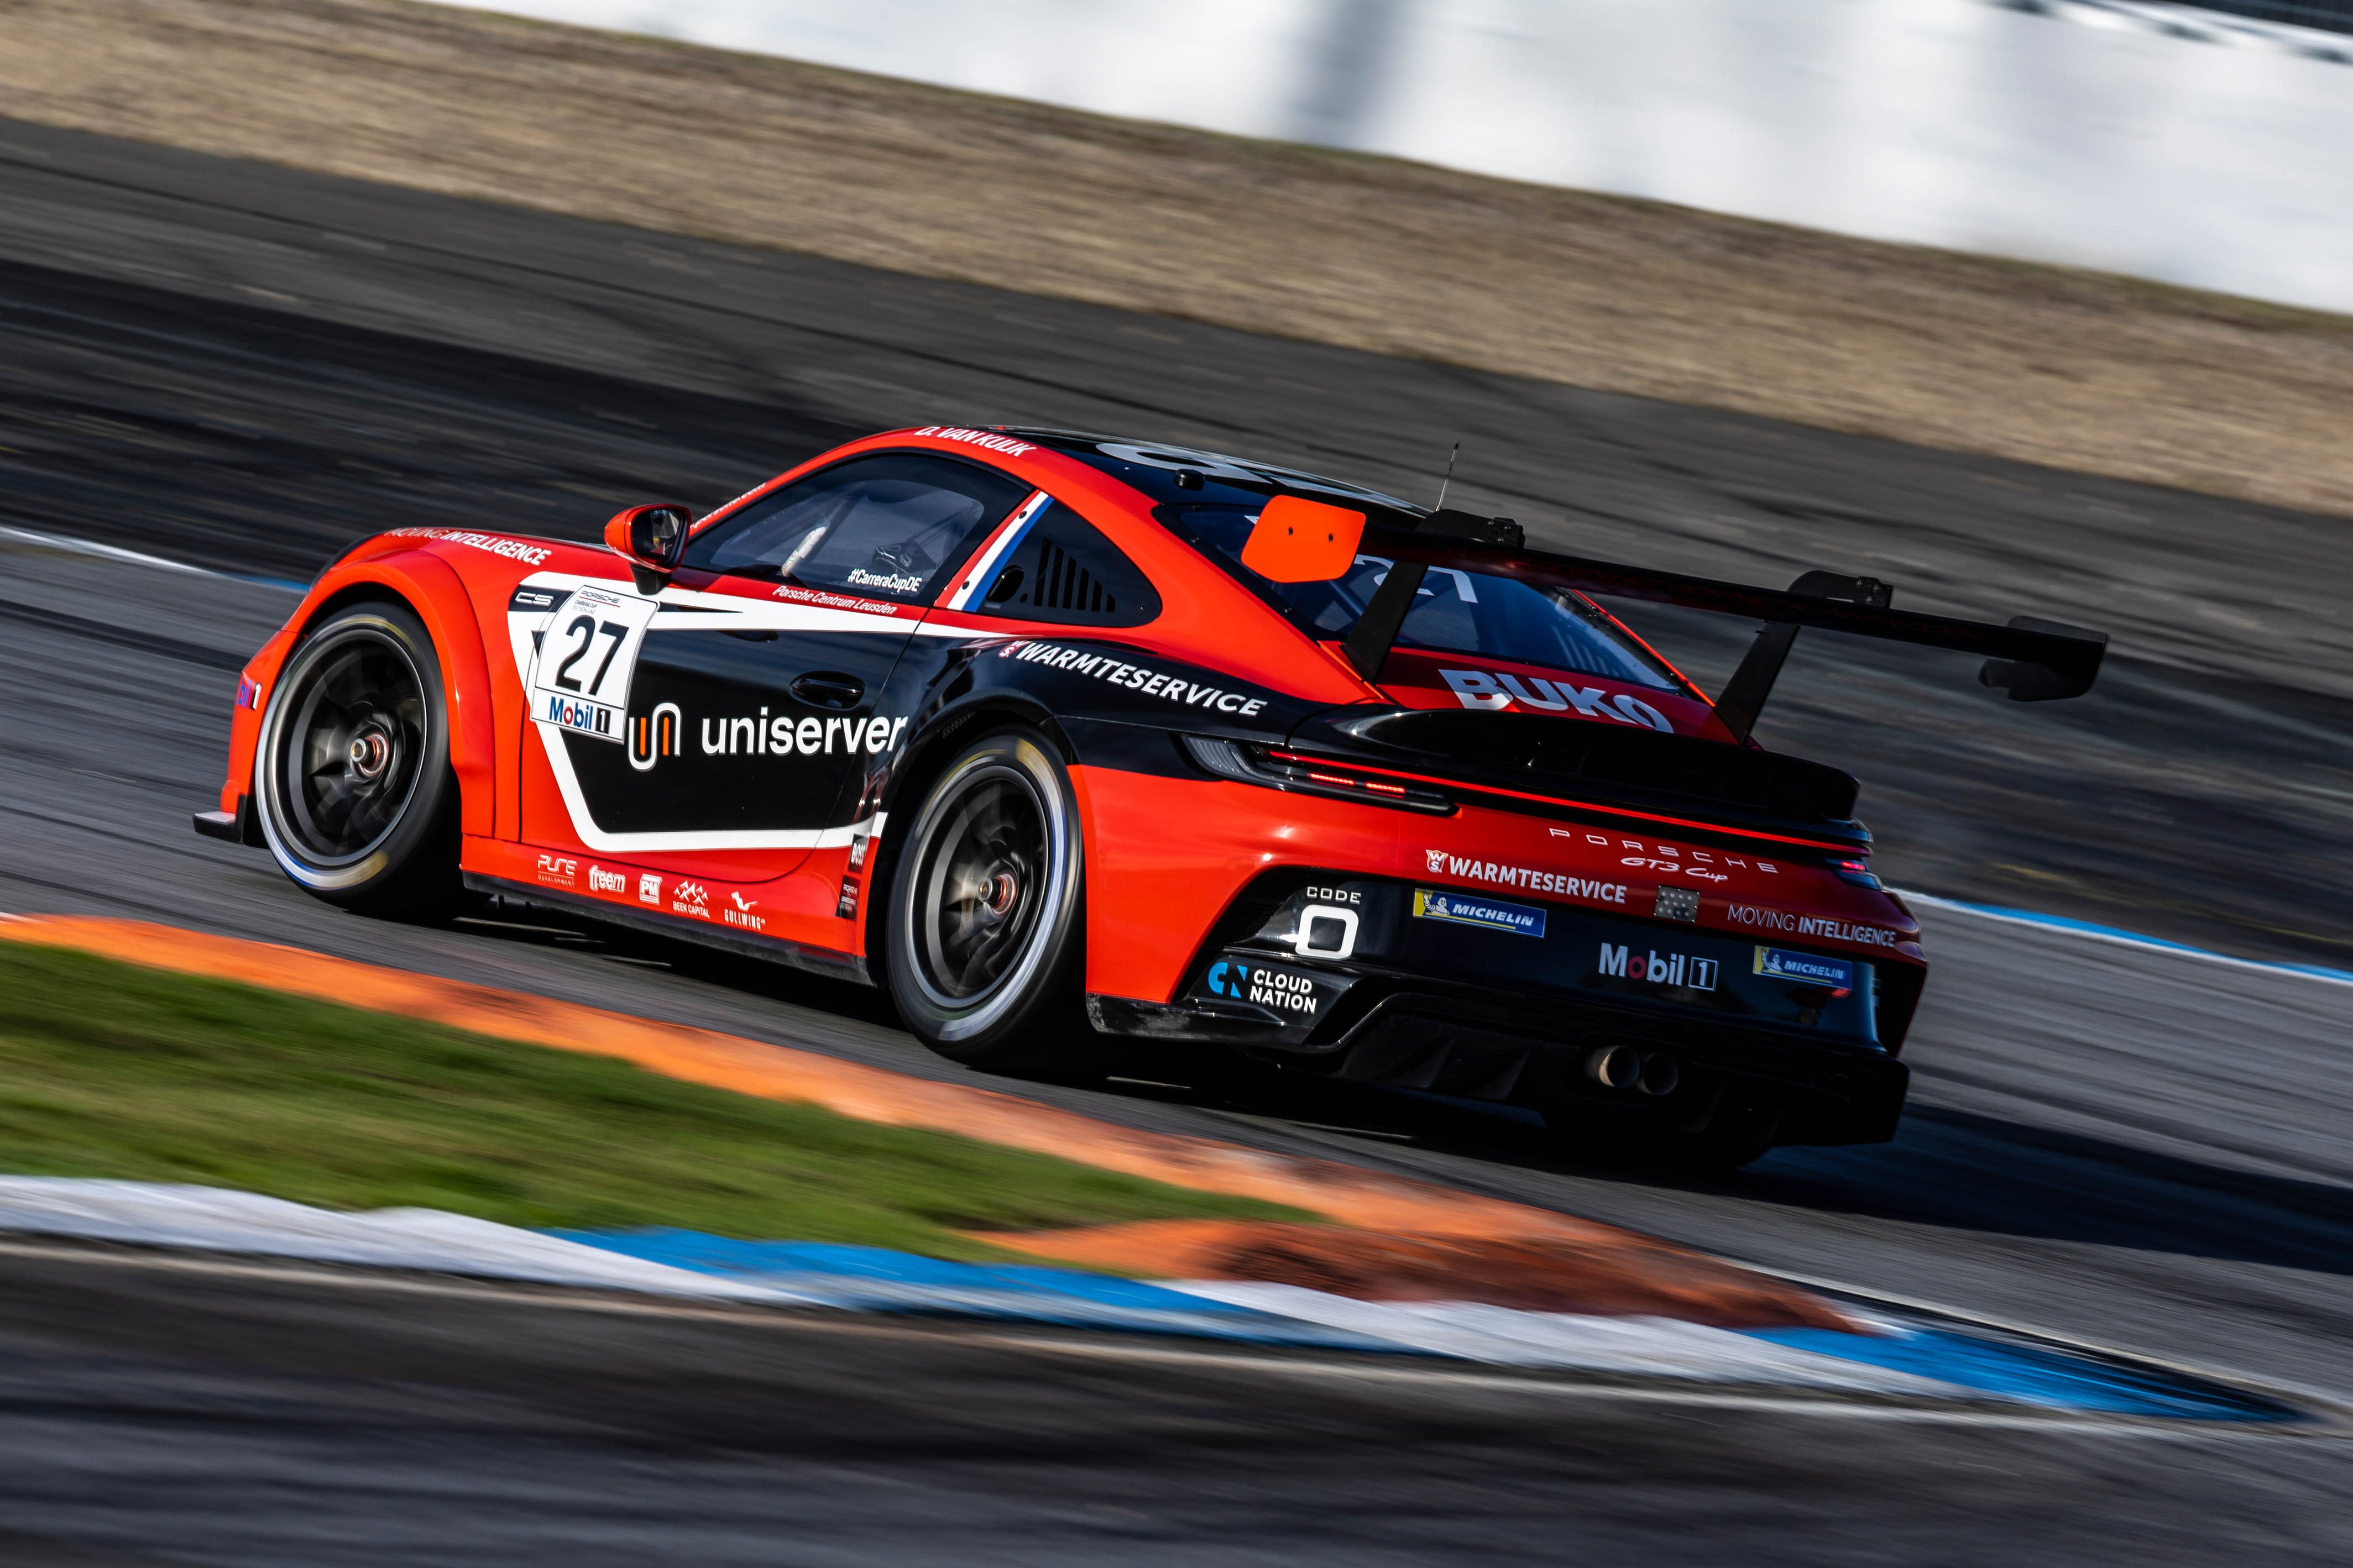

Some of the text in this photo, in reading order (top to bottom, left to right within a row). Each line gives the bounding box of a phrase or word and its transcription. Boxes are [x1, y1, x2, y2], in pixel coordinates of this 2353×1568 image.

[913, 426, 941, 437] D.
[440, 531, 553, 566] INTELLIGENCE
[848, 568, 922, 594] #CarreraCupDE
[581, 590, 620, 604] PORSCHE
[772, 586, 898, 615] Porsche Centrum Leusden
[555, 615, 629, 695] 27
[1016, 642, 1268, 717] WARMTESERVICE
[550, 696, 609, 733] Mobil 1
[1437, 669, 1674, 734] BUKO
[702, 706, 908, 755] uniserver
[1549, 828, 1779, 873] PORSCHE
[537, 854, 578, 876] PURE
[589, 865, 626, 892] freem
[1620, 856, 1729, 883] GT3 Cup
[537, 874, 575, 887] DEVELOPMENT
[641, 880, 658, 896] PM
[1449, 856, 1627, 904] WARMTESERVICE
[1306, 886, 1362, 905] CODE
[673, 901, 710, 919] BEEK CAPITAL
[724, 909, 761, 930] GULLWING
[1452, 902, 1535, 927] MICHELIN
[1727, 903, 1897, 948] MOVING INTELLIGENCE
[1598, 941, 1686, 987] Mobil
[1784, 961, 1845, 980] MICHELIN
[1253, 968, 1314, 994] CLOUD
[1249, 985, 1317, 1015] NATION
